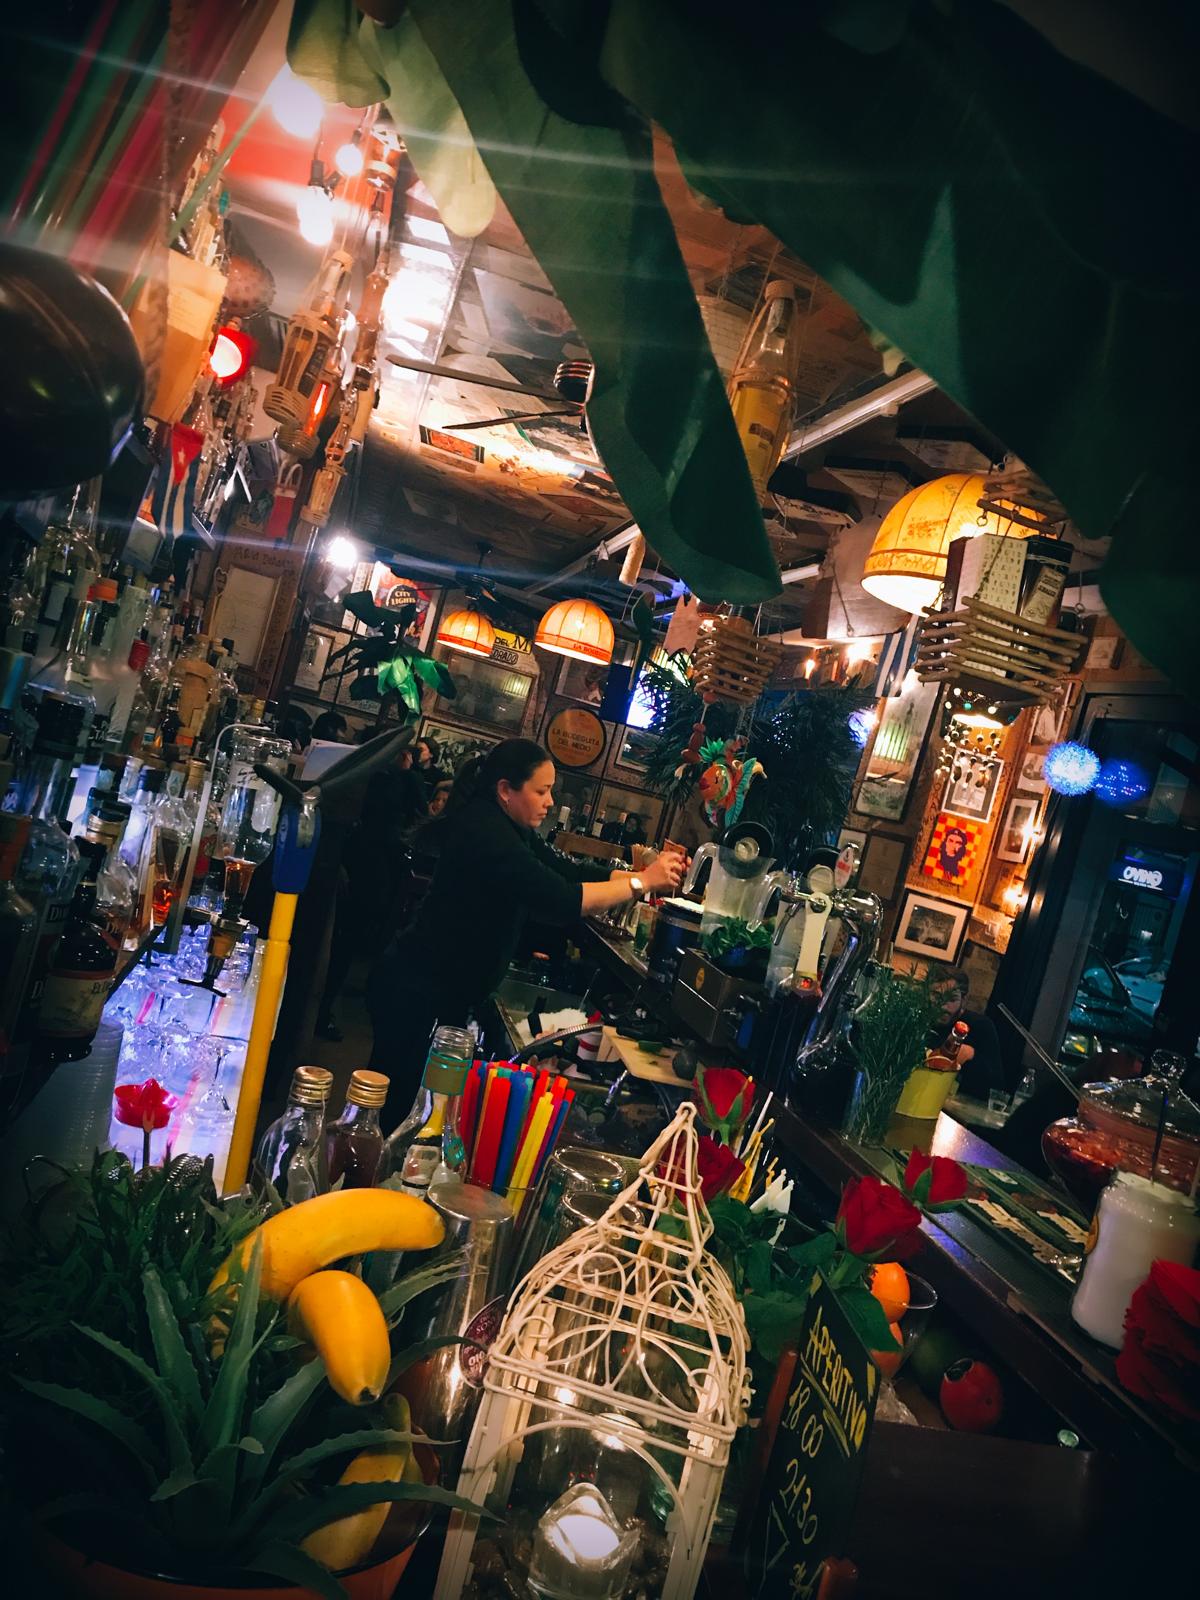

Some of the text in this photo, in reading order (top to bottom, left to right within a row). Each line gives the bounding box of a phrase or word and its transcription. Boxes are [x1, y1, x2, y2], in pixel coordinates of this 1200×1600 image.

[394, 589, 411, 598] CITY
[391, 596, 416, 606] LIGHTS
[805, 1305, 867, 1453] APERITIVO
